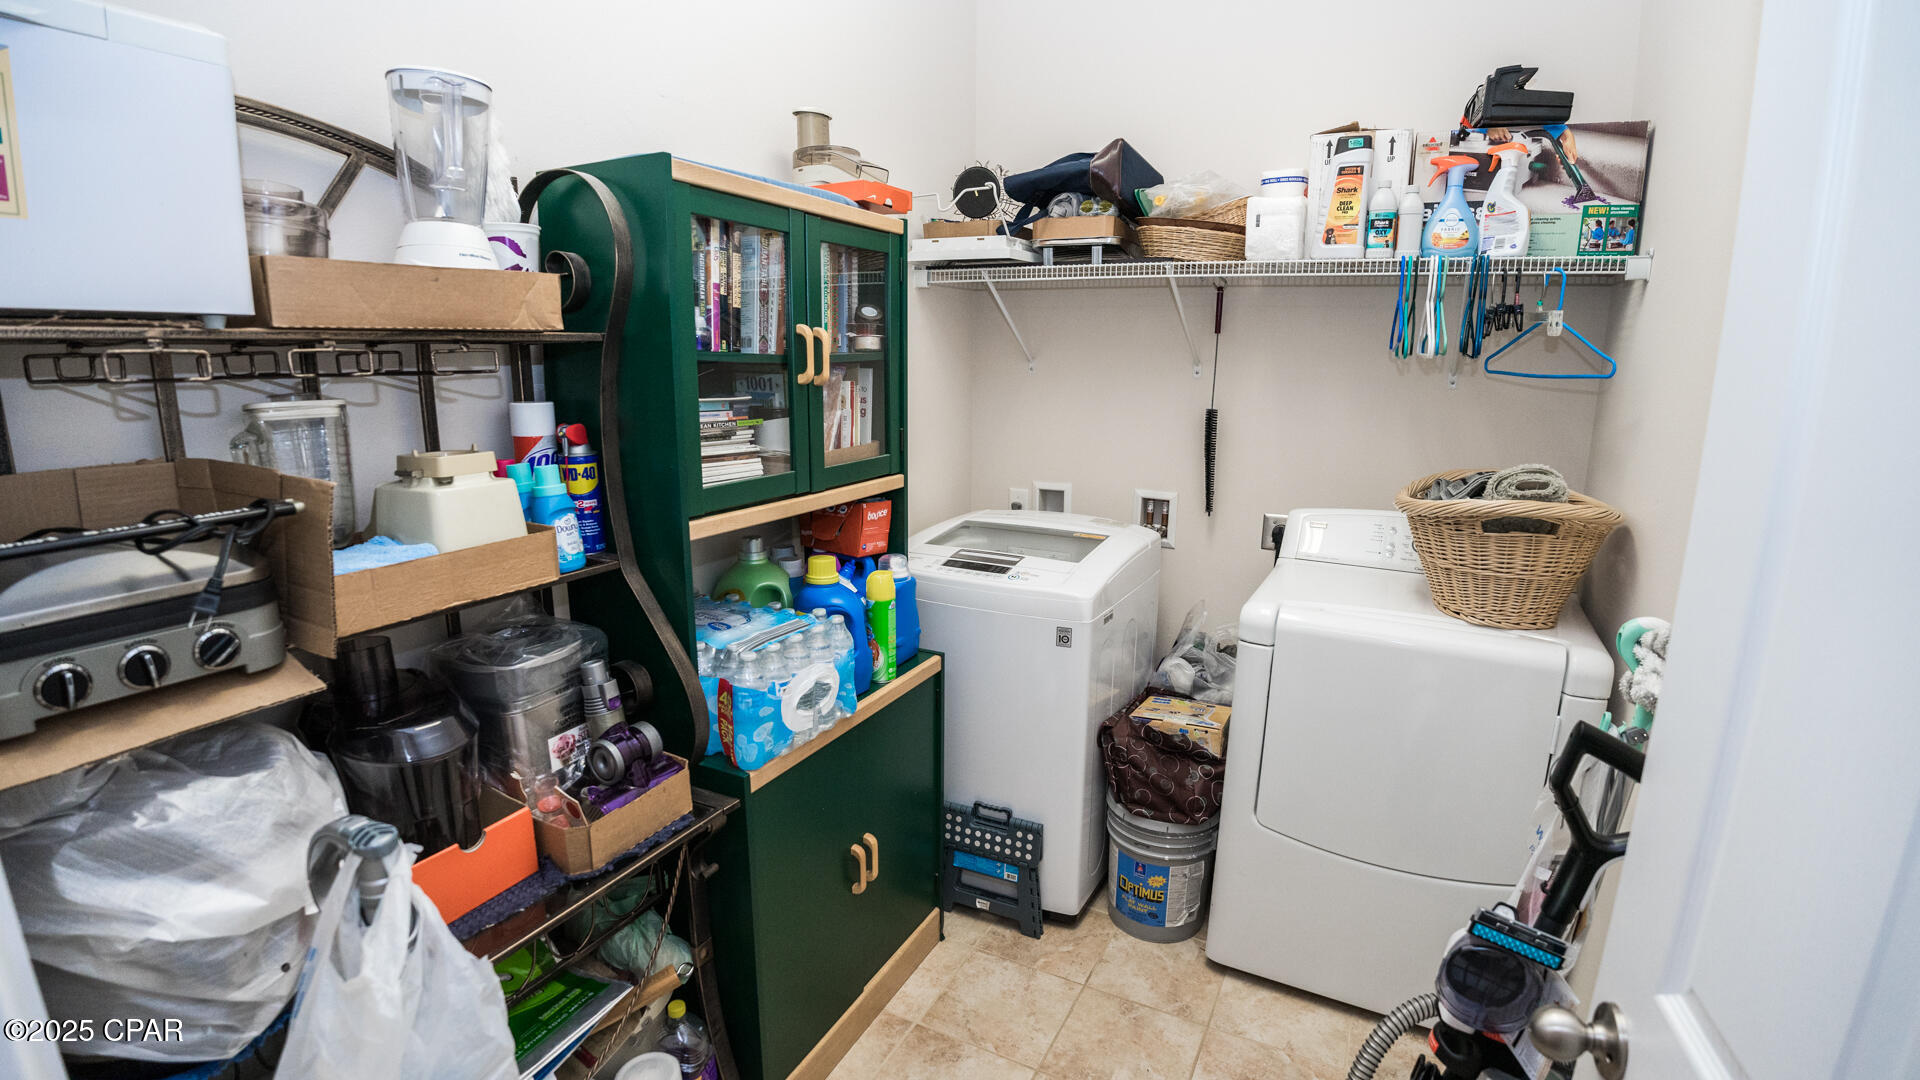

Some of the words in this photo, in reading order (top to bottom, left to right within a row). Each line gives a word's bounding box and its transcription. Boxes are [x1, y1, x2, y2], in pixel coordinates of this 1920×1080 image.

[1386, 155, 1396, 163] UP
[1336, 186, 1359, 194] Shark
[1588, 206, 1610, 215] NEW!
[712, 421, 736, 429] KITCHEN
[562, 466, 596, 481] WD-40
[867, 508, 888, 521] bounce
